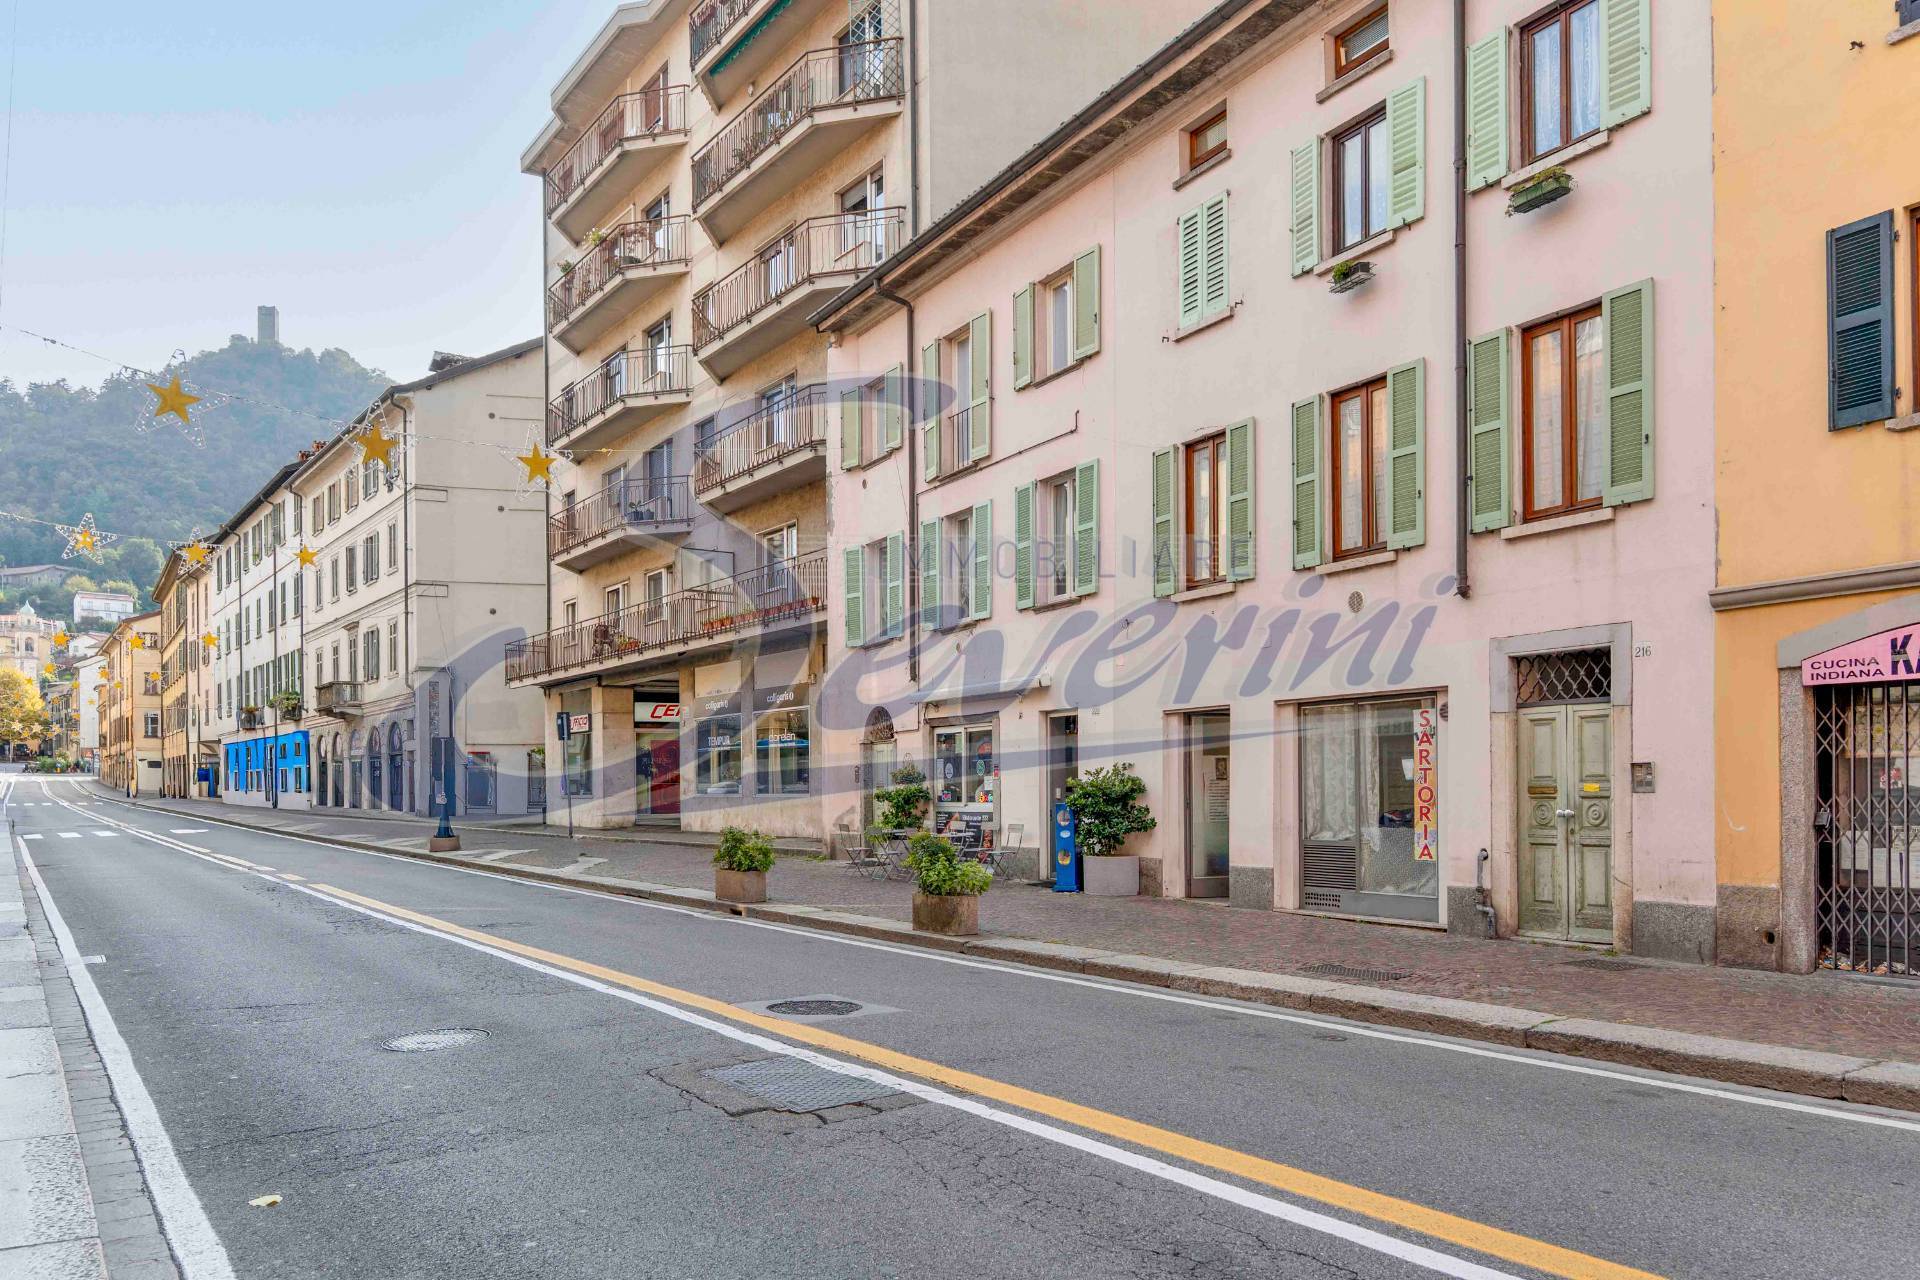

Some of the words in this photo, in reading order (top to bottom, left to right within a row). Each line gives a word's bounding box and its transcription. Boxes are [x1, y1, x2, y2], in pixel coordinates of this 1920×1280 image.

[1634, 645, 1652, 658] 216
[1890, 633, 1920, 676] K
[1810, 656, 1880, 670] CUCINA
[1810, 668, 1885, 681] INDIANA
[1417, 709, 1434, 860] SARTORIA
